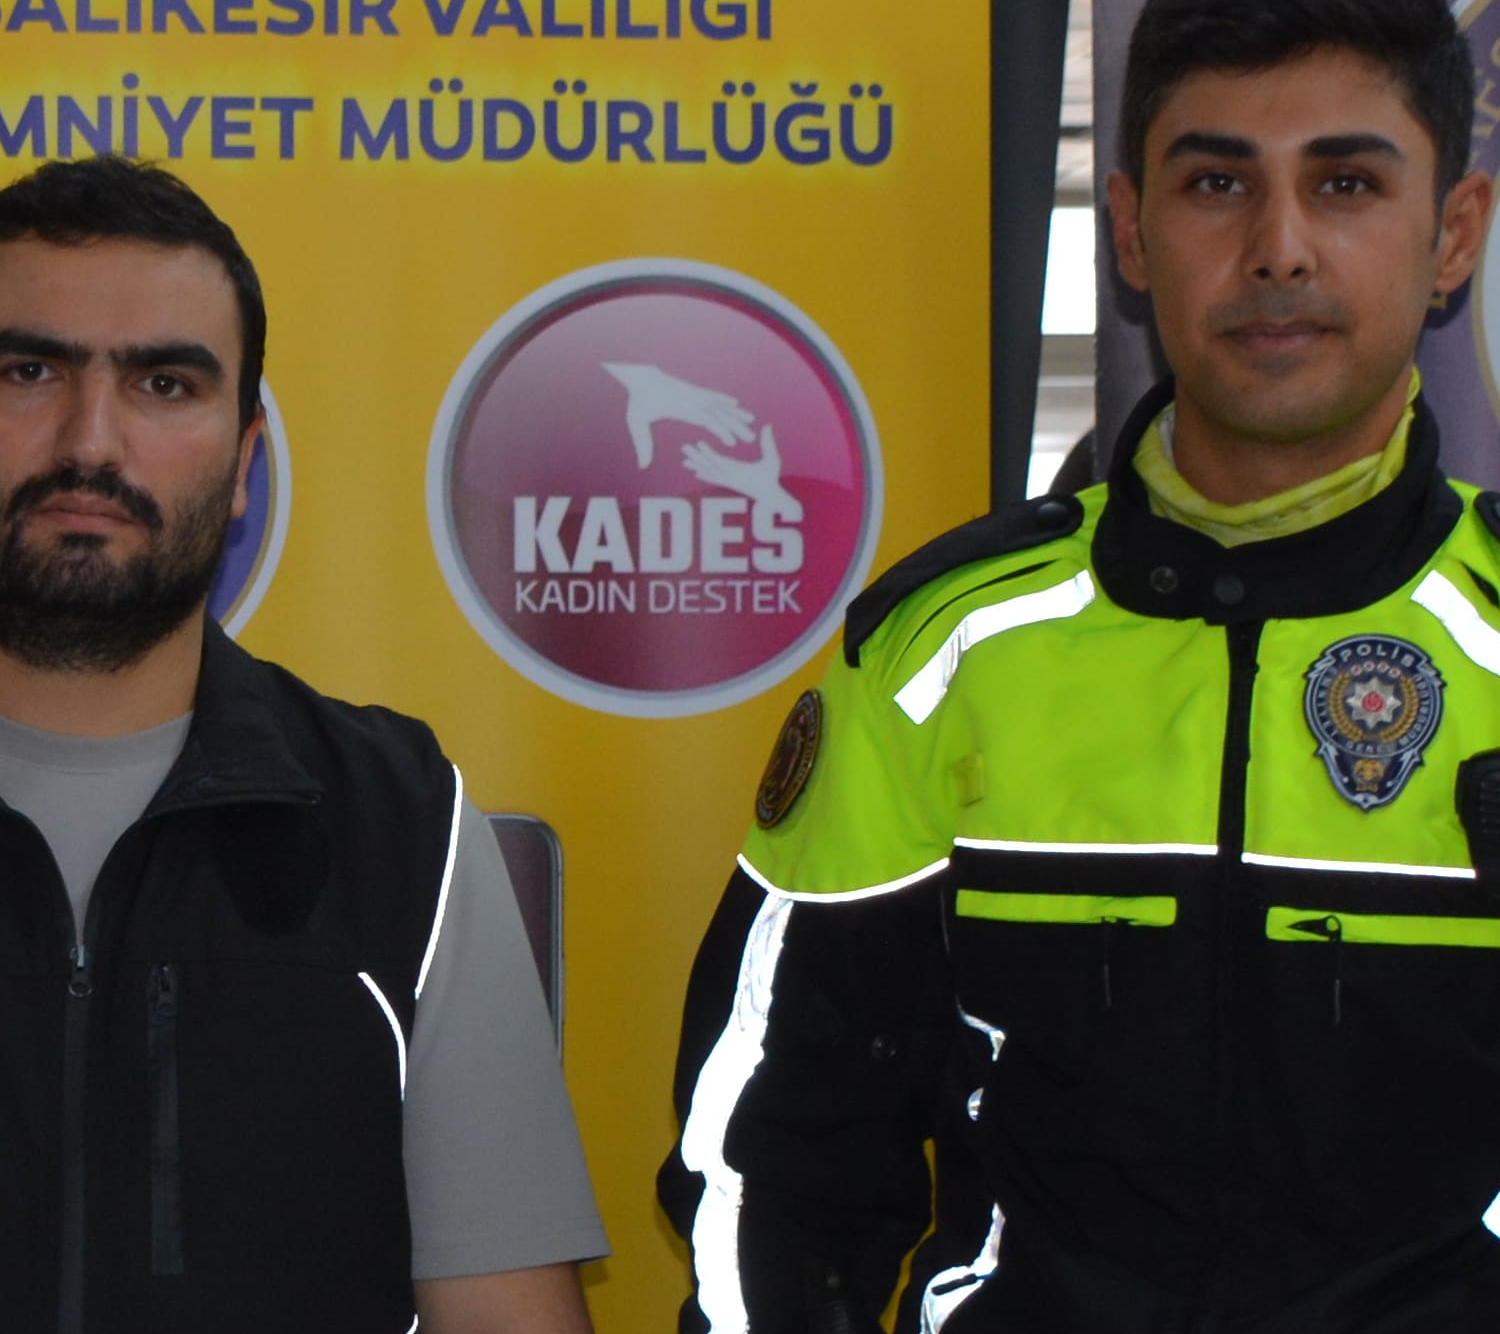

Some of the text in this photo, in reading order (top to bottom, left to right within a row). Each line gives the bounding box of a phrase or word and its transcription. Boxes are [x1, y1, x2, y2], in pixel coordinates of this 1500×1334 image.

[338, 77, 895, 167] MÜDÜRLÜĞÜ
[512, 494, 805, 567] KADES
[513, 575, 802, 616] KADIN DESTEK
